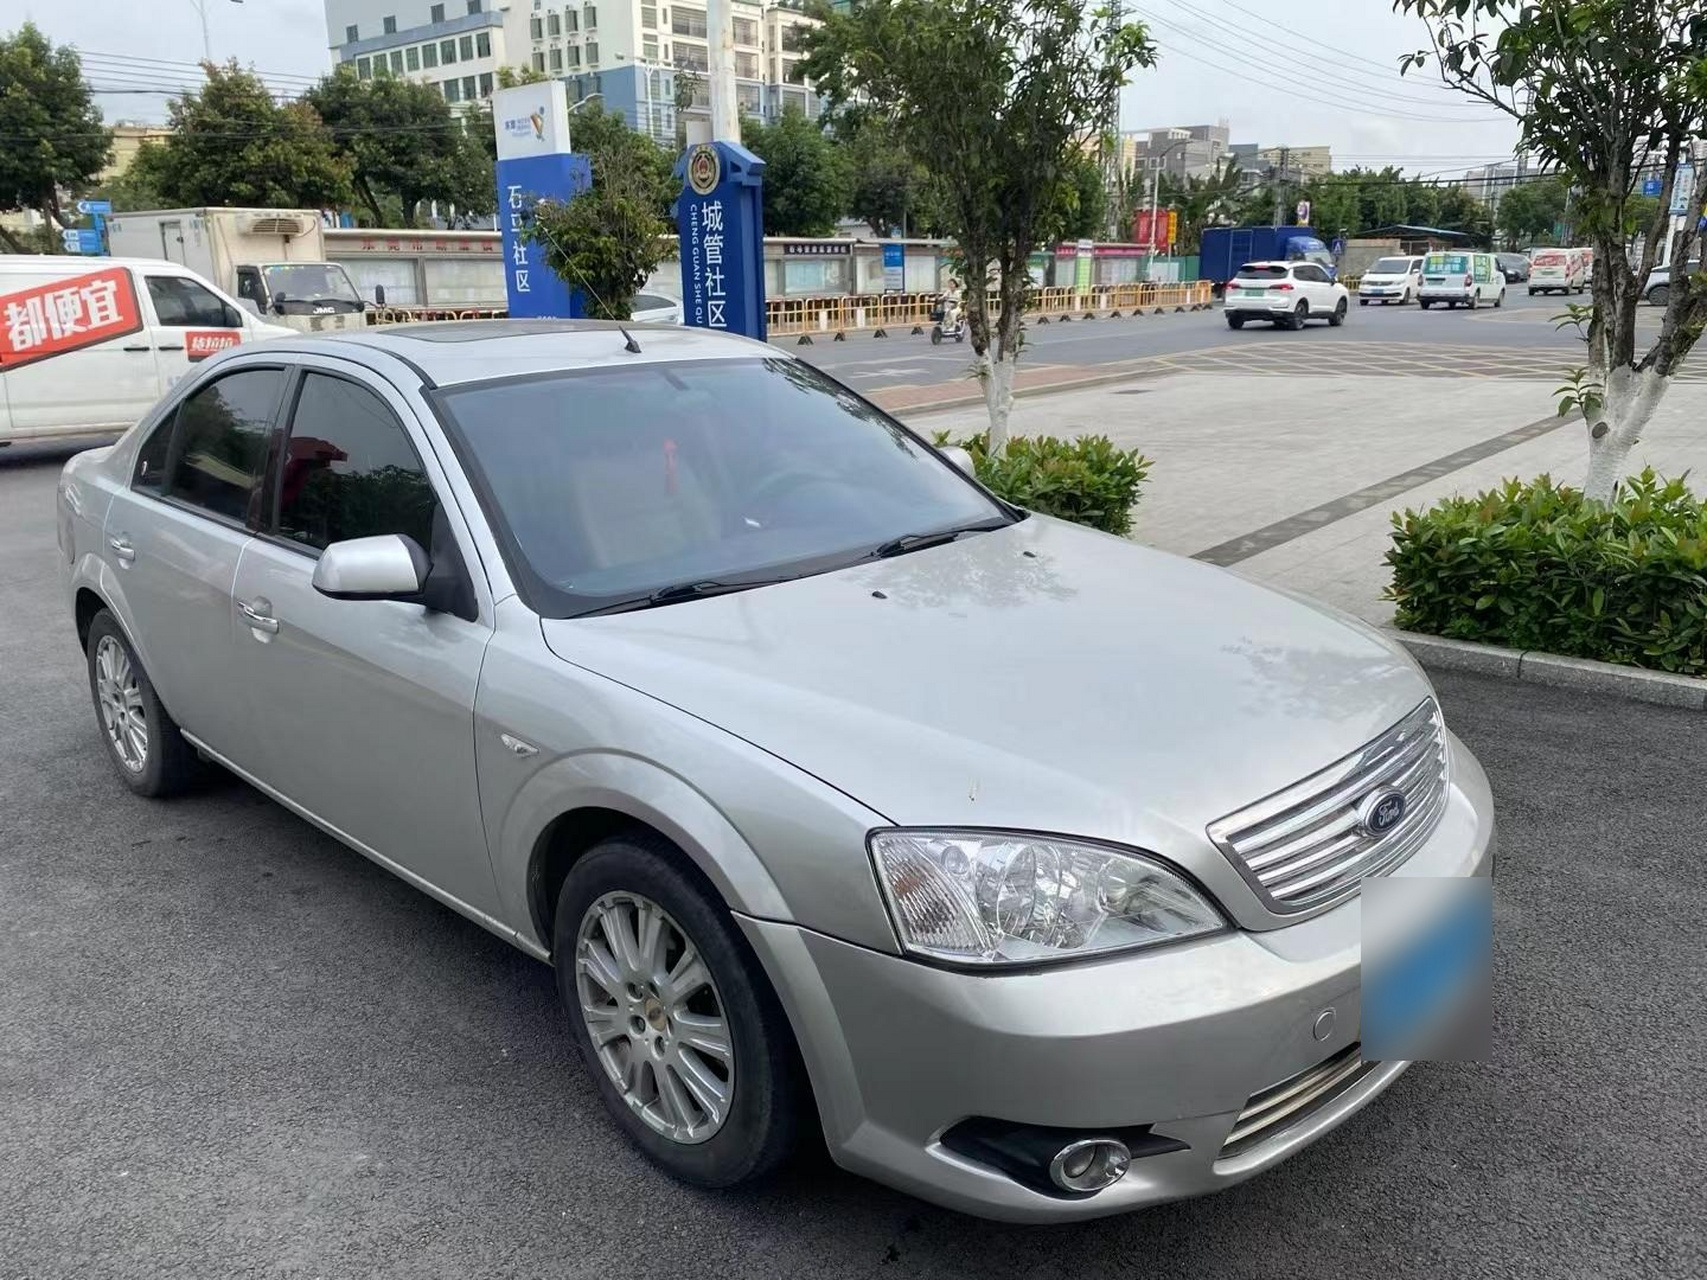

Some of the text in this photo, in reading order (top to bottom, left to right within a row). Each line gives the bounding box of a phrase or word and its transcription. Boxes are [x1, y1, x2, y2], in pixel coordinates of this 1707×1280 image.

[690, 204, 703, 324] CHENG GUAN SHE QU
[701, 200, 727, 327] 城管社区
[3, 279, 124, 352] 都便宜
[313, 306, 335, 314] JMC
[1378, 800, 1400, 826] Ford
